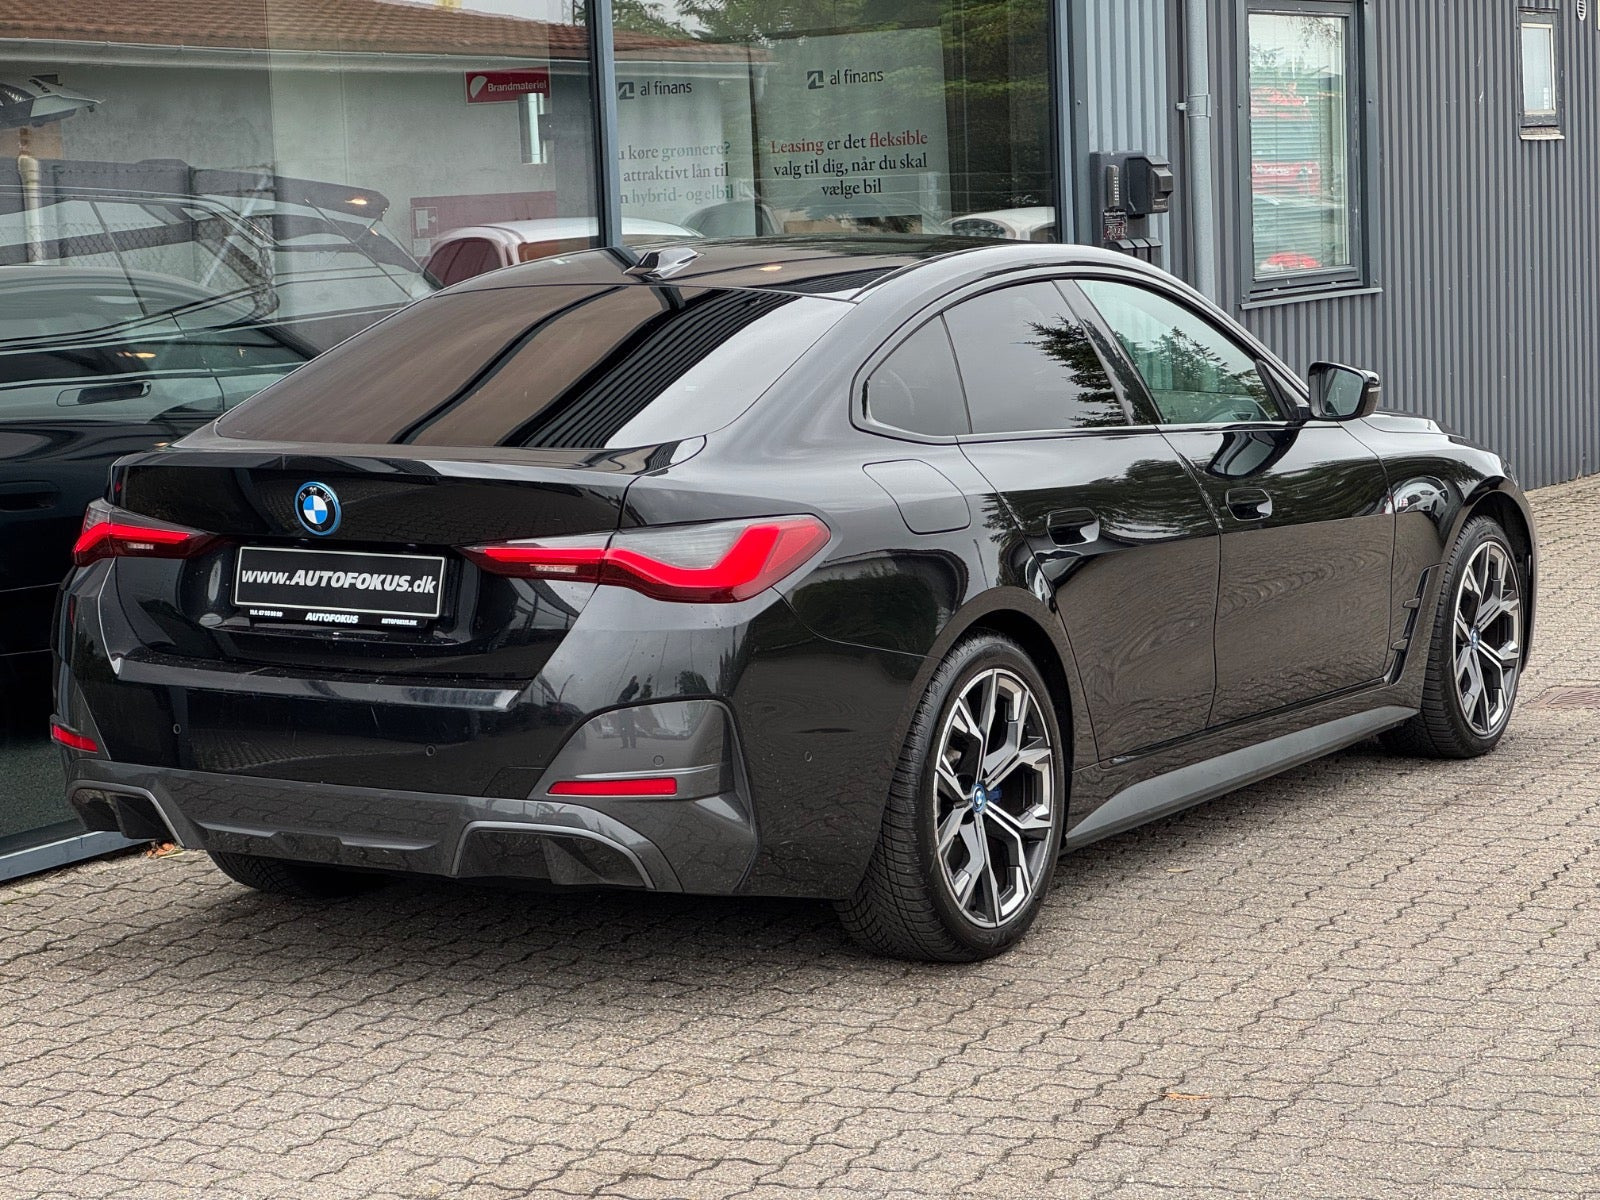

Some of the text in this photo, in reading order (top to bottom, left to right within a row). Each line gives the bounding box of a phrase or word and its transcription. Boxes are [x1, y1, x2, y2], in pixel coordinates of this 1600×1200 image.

[487, 80, 547, 92] Brandmateriel
[829, 69, 884, 85] al finans
[640, 81, 692, 96] al finans
[628, 145, 659, 160] køre
[661, 141, 731, 161] grønnere?
[771, 129, 928, 155] Leasing er det fleksible
[623, 161, 729, 182] attraktivt lån til
[773, 152, 928, 179] valg til dig, når du skal
[631, 186, 682, 207] hybrid-
[686, 190, 704, 205] og
[704, 184, 734, 200] elbil
[821, 178, 882, 199] vælge bil
[241, 569, 437, 594] www.AUTOFOKUS.dk
[304, 612, 359, 624] AUTOFOKUS
